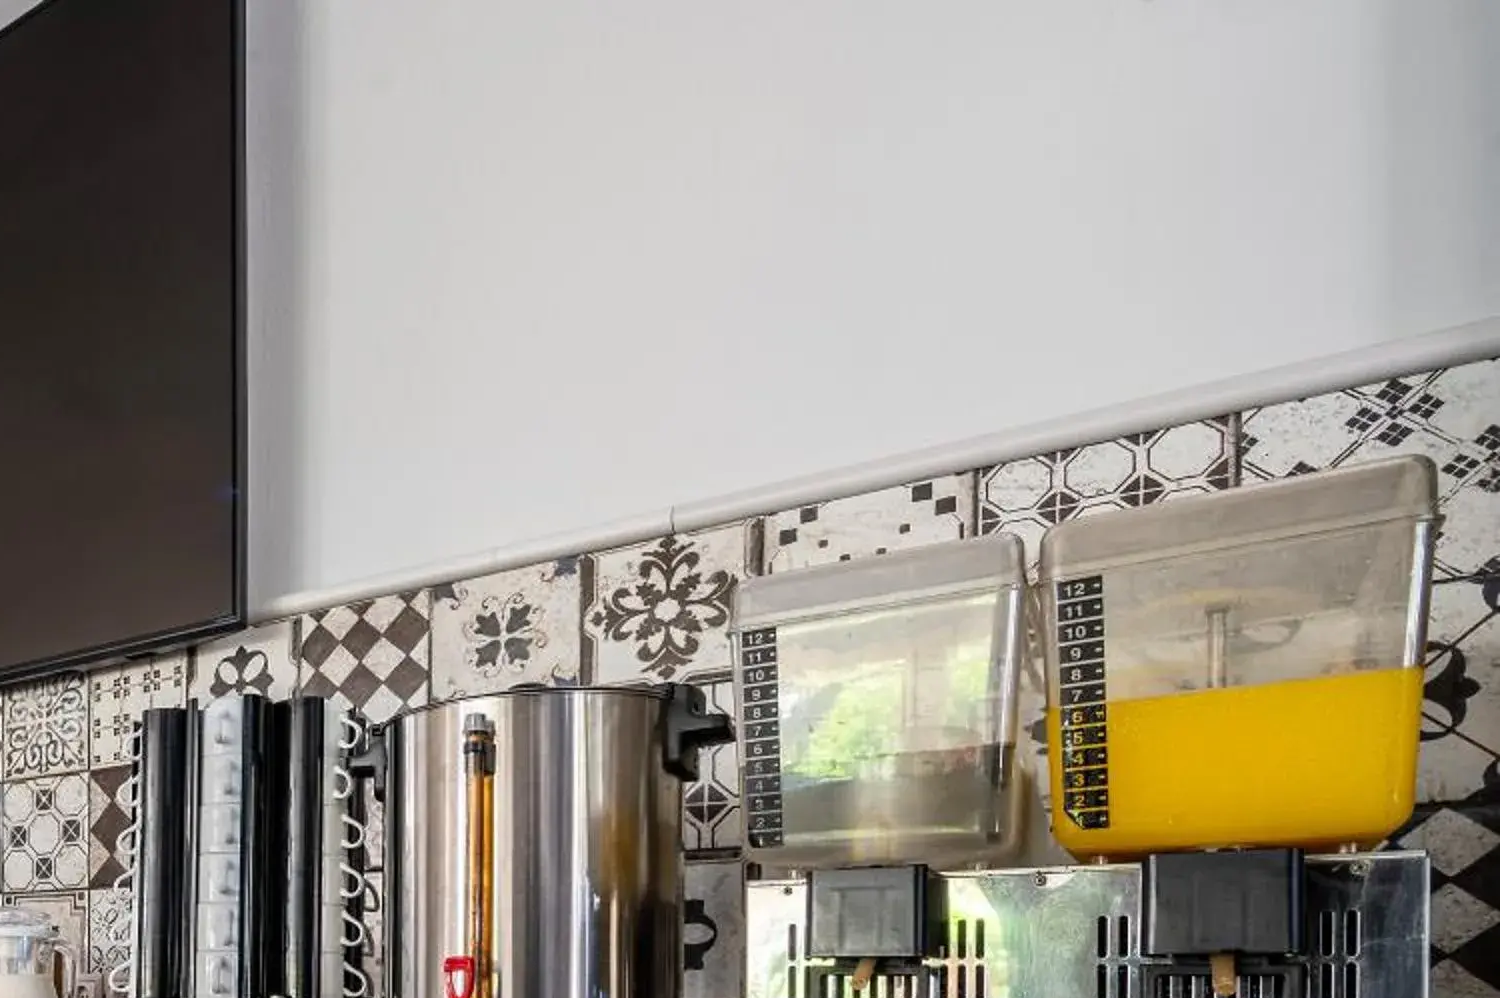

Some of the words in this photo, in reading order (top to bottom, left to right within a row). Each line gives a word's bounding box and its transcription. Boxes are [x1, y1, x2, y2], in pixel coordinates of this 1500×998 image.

[1064, 582, 1085, 597] 12
[1065, 605, 1083, 617] 11
[747, 633, 764, 644] 12
[1064, 625, 1086, 640] 10
[748, 653, 762, 663] 11
[1070, 647, 1081, 660] 9
[748, 670, 765, 681] 10
[1070, 668, 1082, 681] 8
[751, 690, 761, 700] 9
[1071, 690, 1082, 702] 7
[753, 708, 762, 718] 8
[1072, 711, 1083, 723] 6
[753, 727, 763, 737] 7
[1073, 732, 1084, 744] 5
[753, 744, 763, 755] 6
[1073, 753, 1084, 765] 4
[1073, 773, 1085, 786] 3
[1074, 795, 1085, 807] 2
[755, 818, 765, 828] 2
